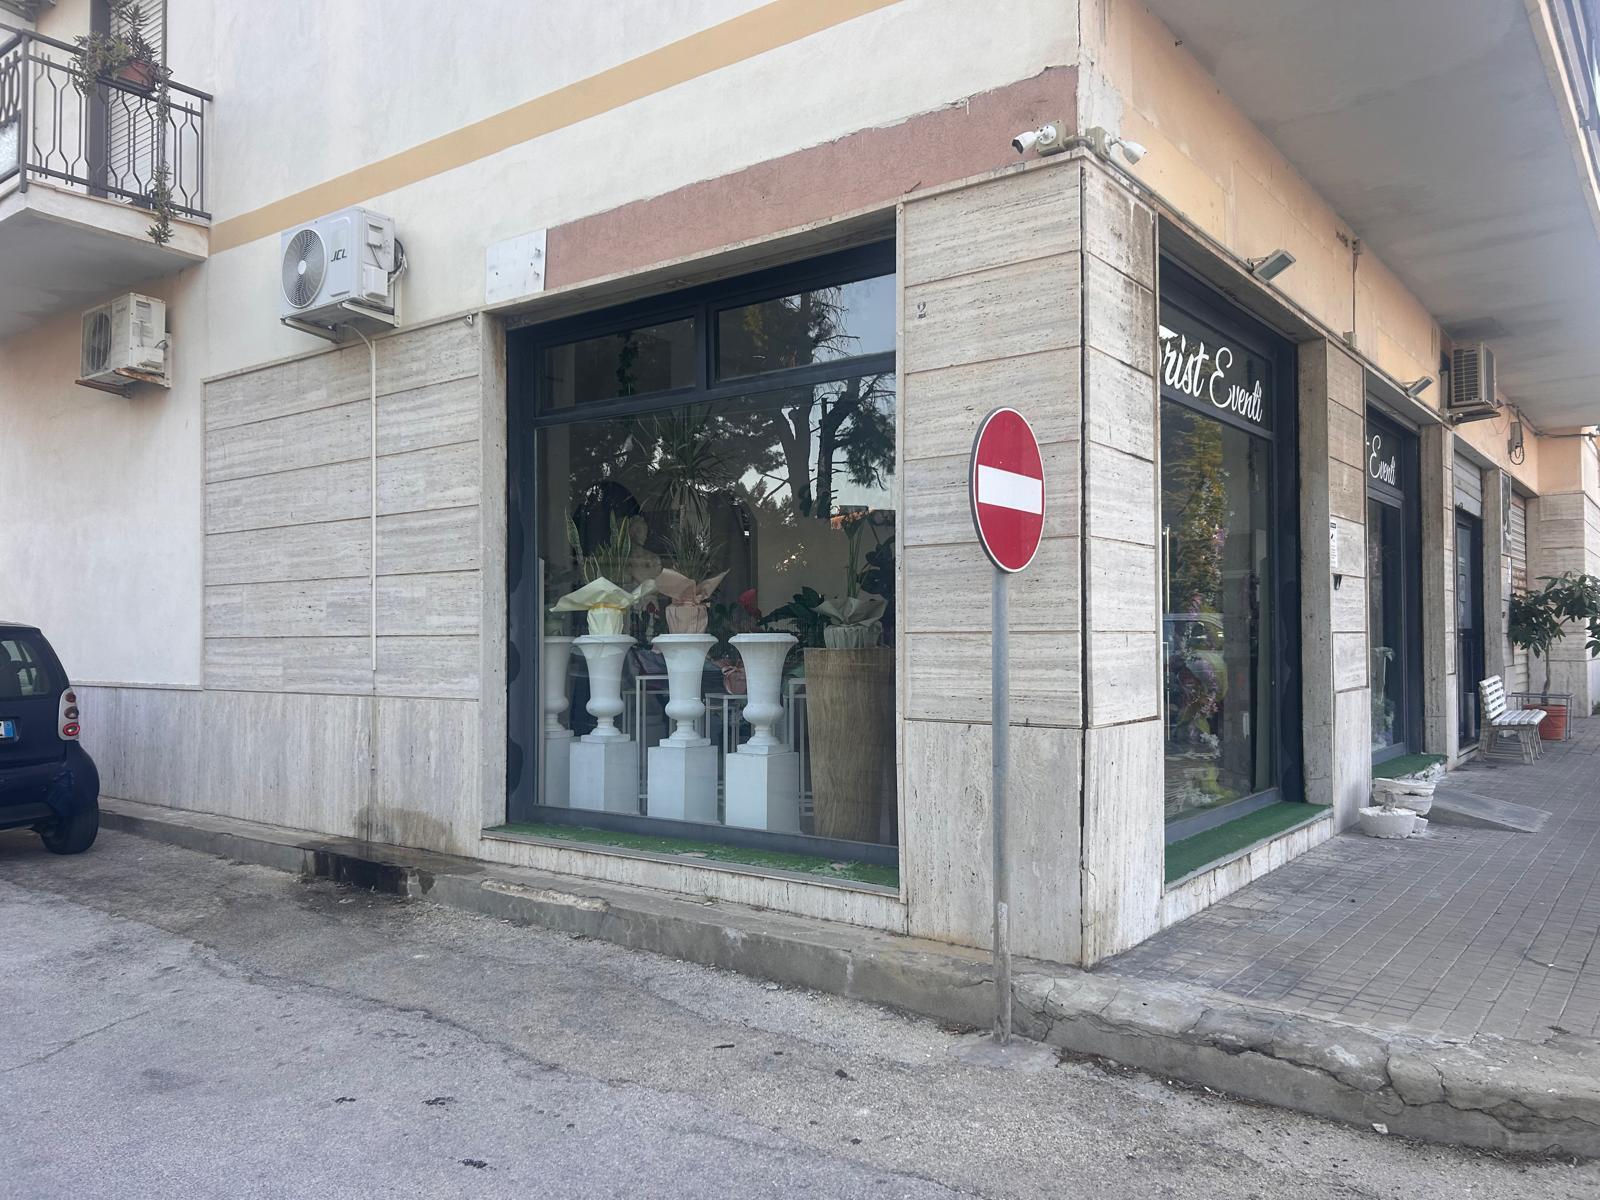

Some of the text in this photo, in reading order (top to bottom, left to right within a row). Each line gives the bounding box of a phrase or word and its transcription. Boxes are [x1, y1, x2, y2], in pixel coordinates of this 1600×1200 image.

[330, 249, 347, 262] JCL
[1159, 325, 1263, 422] rist Eventi
